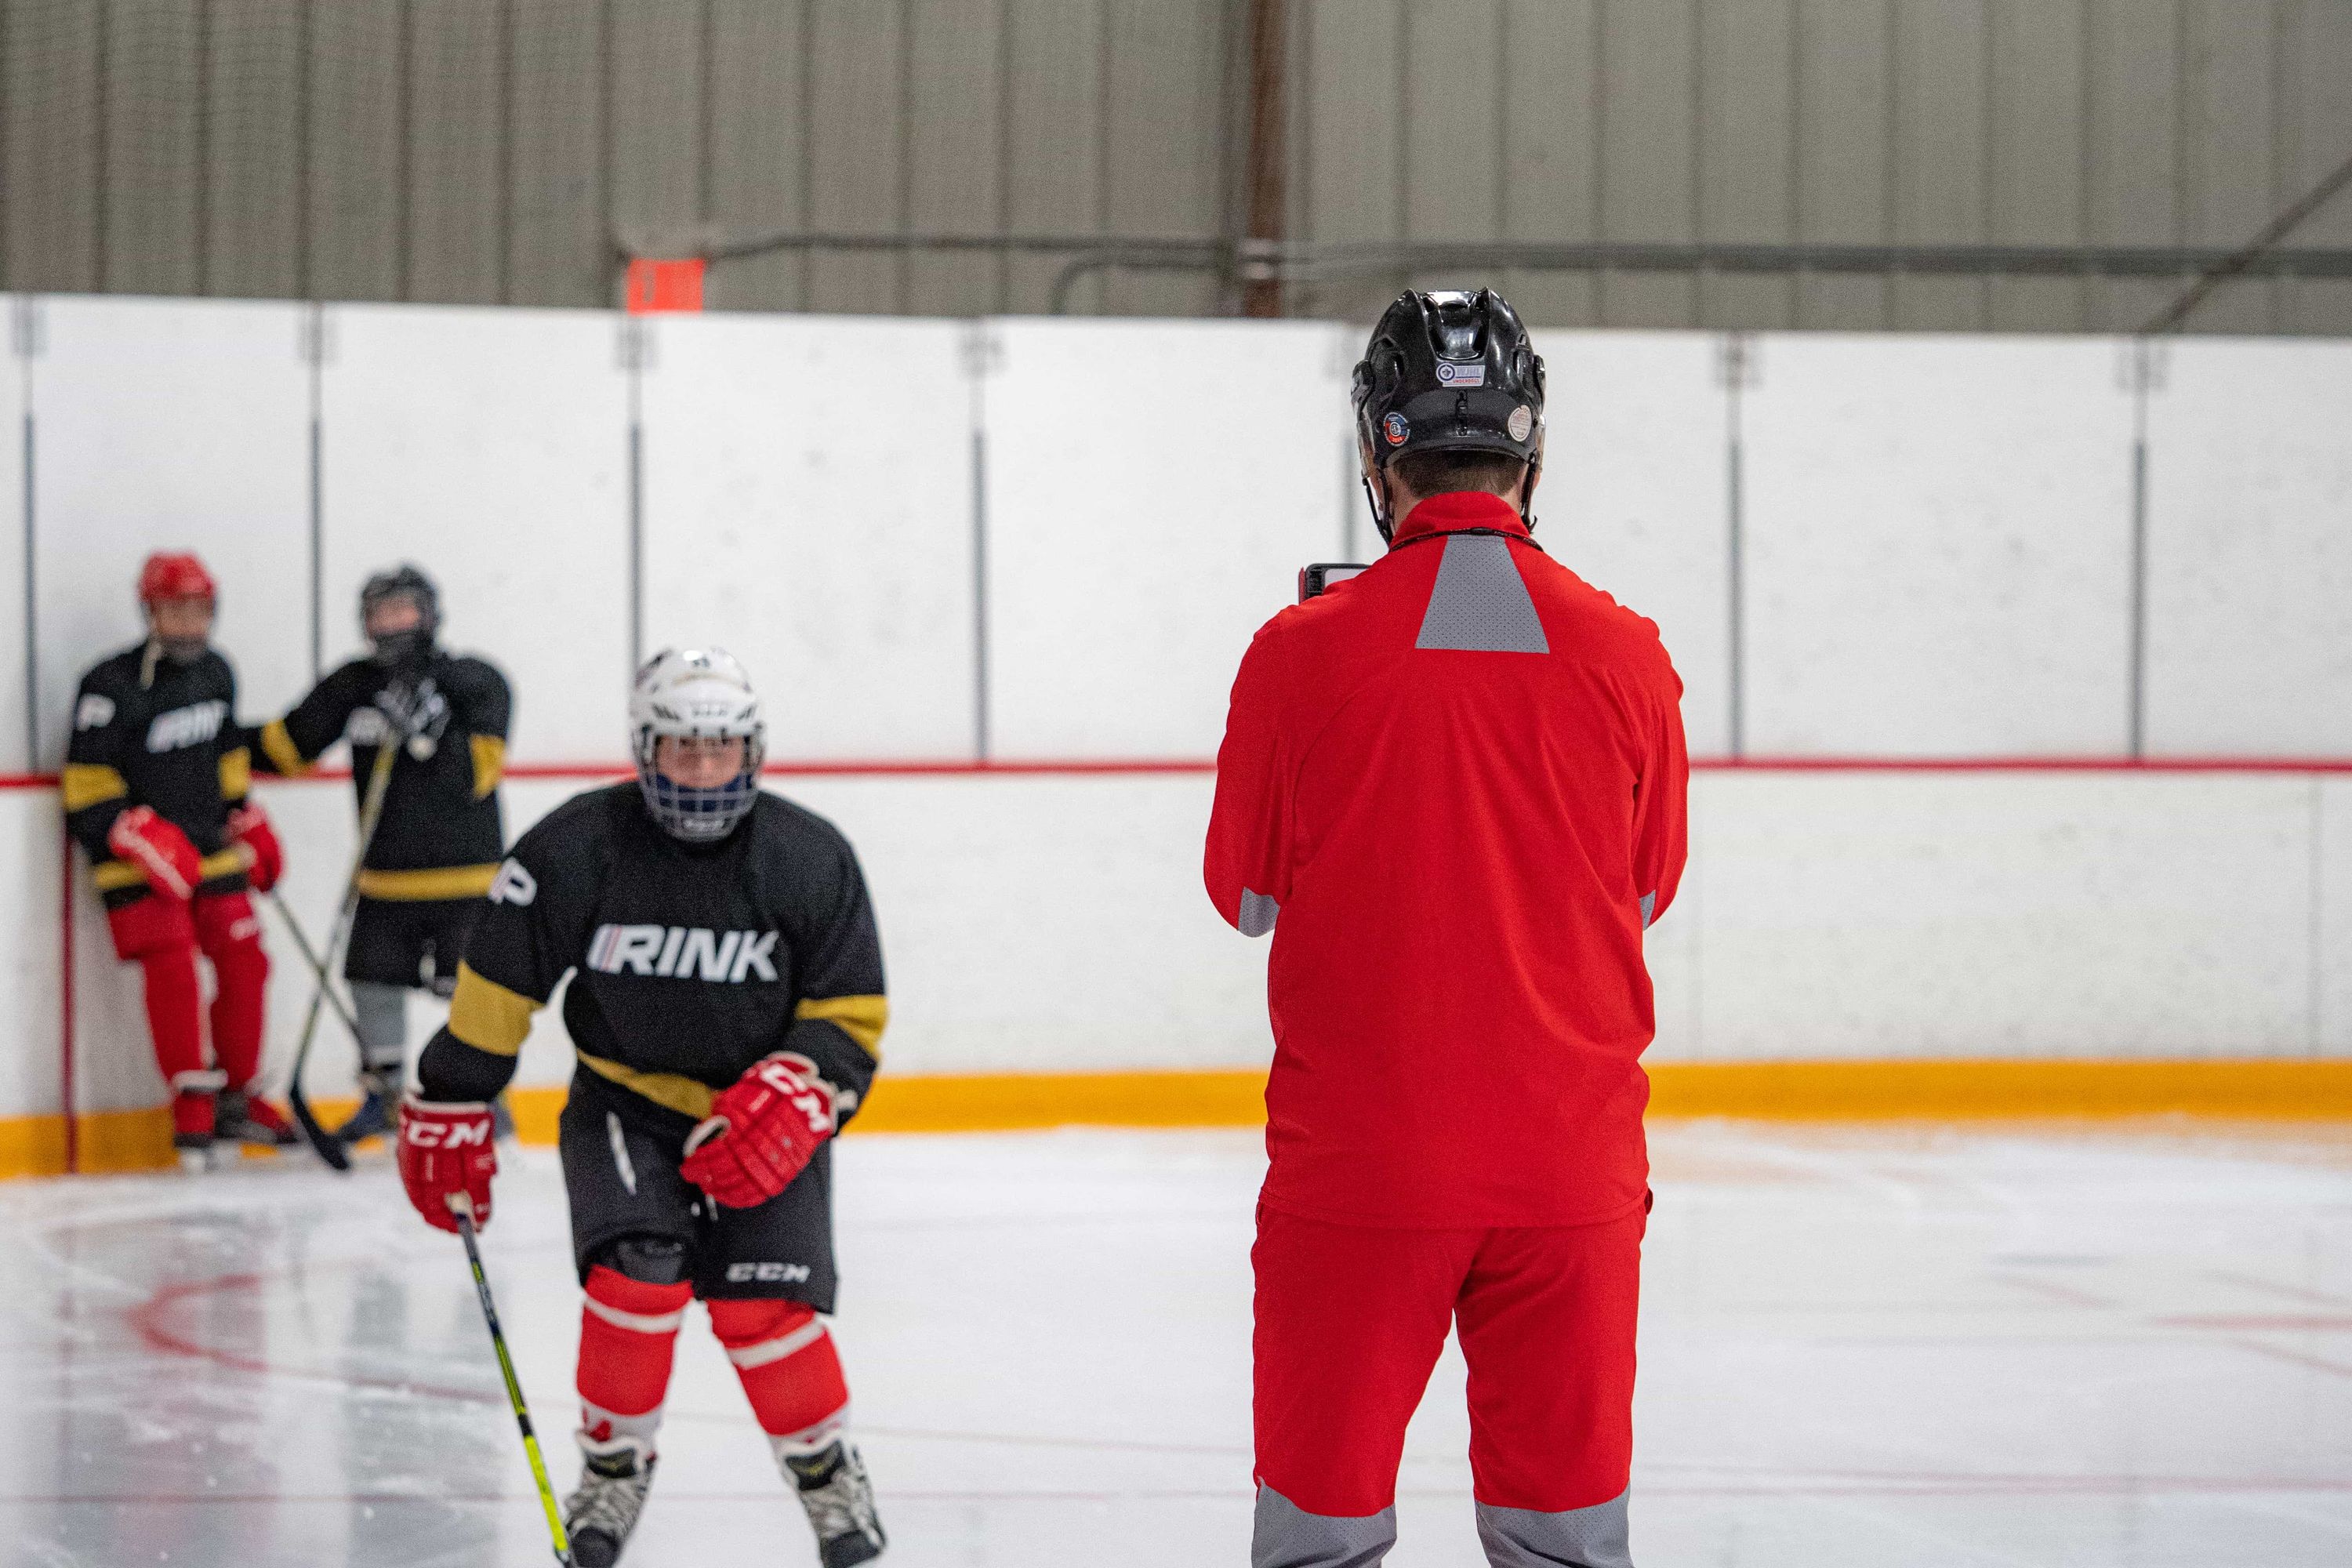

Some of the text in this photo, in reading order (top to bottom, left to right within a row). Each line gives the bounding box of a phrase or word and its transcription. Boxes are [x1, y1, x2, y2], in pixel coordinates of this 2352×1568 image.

[586, 924, 780, 983] RINK
[399, 1118, 491, 1149] CM
[725, 1262, 811, 1283] CCM
